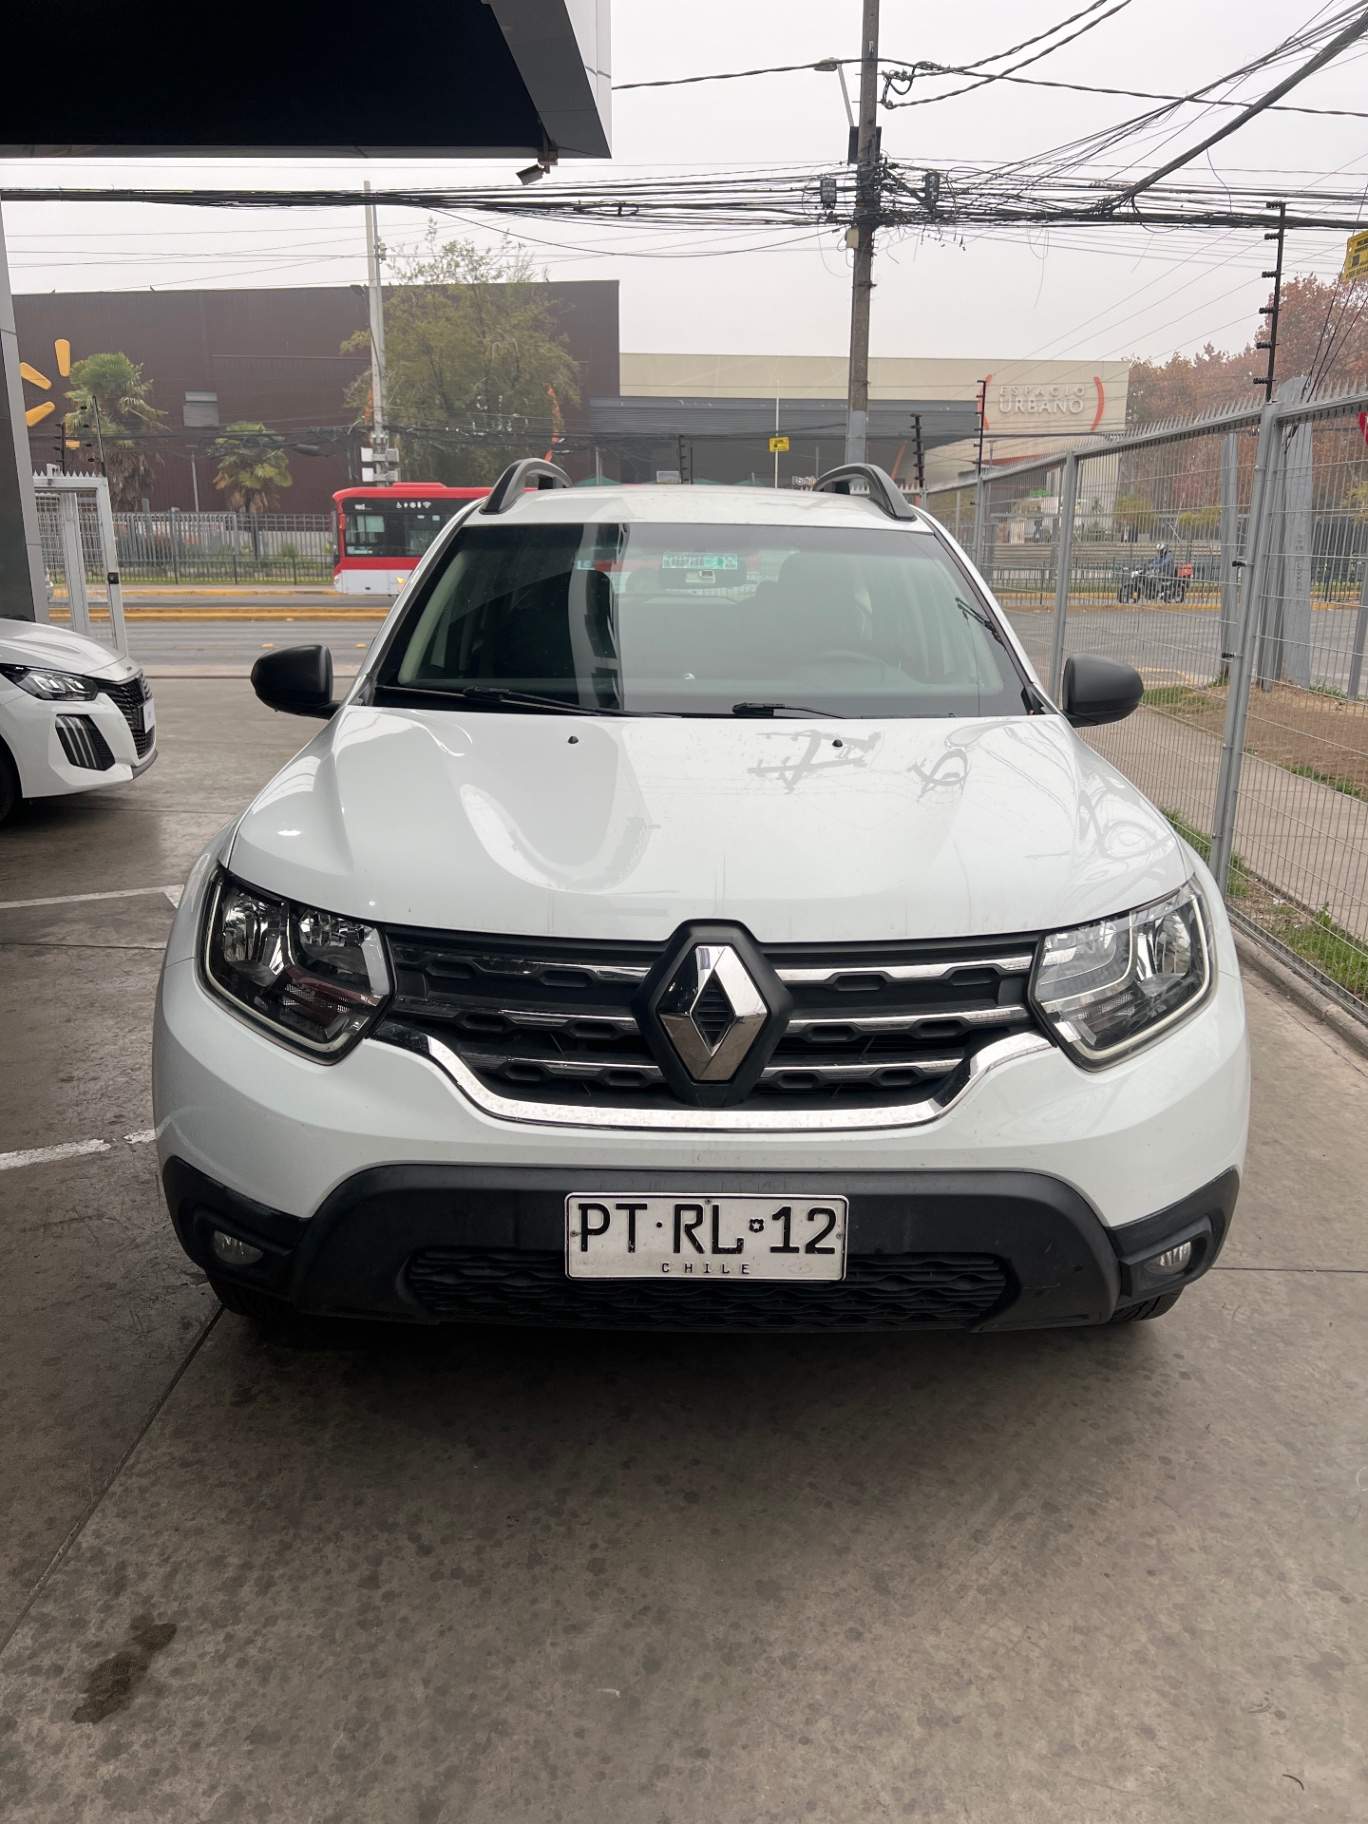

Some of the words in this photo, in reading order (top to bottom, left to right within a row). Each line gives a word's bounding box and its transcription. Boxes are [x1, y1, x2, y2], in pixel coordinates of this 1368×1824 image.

[1000, 384, 1085, 397] ESPACIO
[1000, 397, 1083, 413] URBANO
[661, 1262, 750, 1274] CHILE
